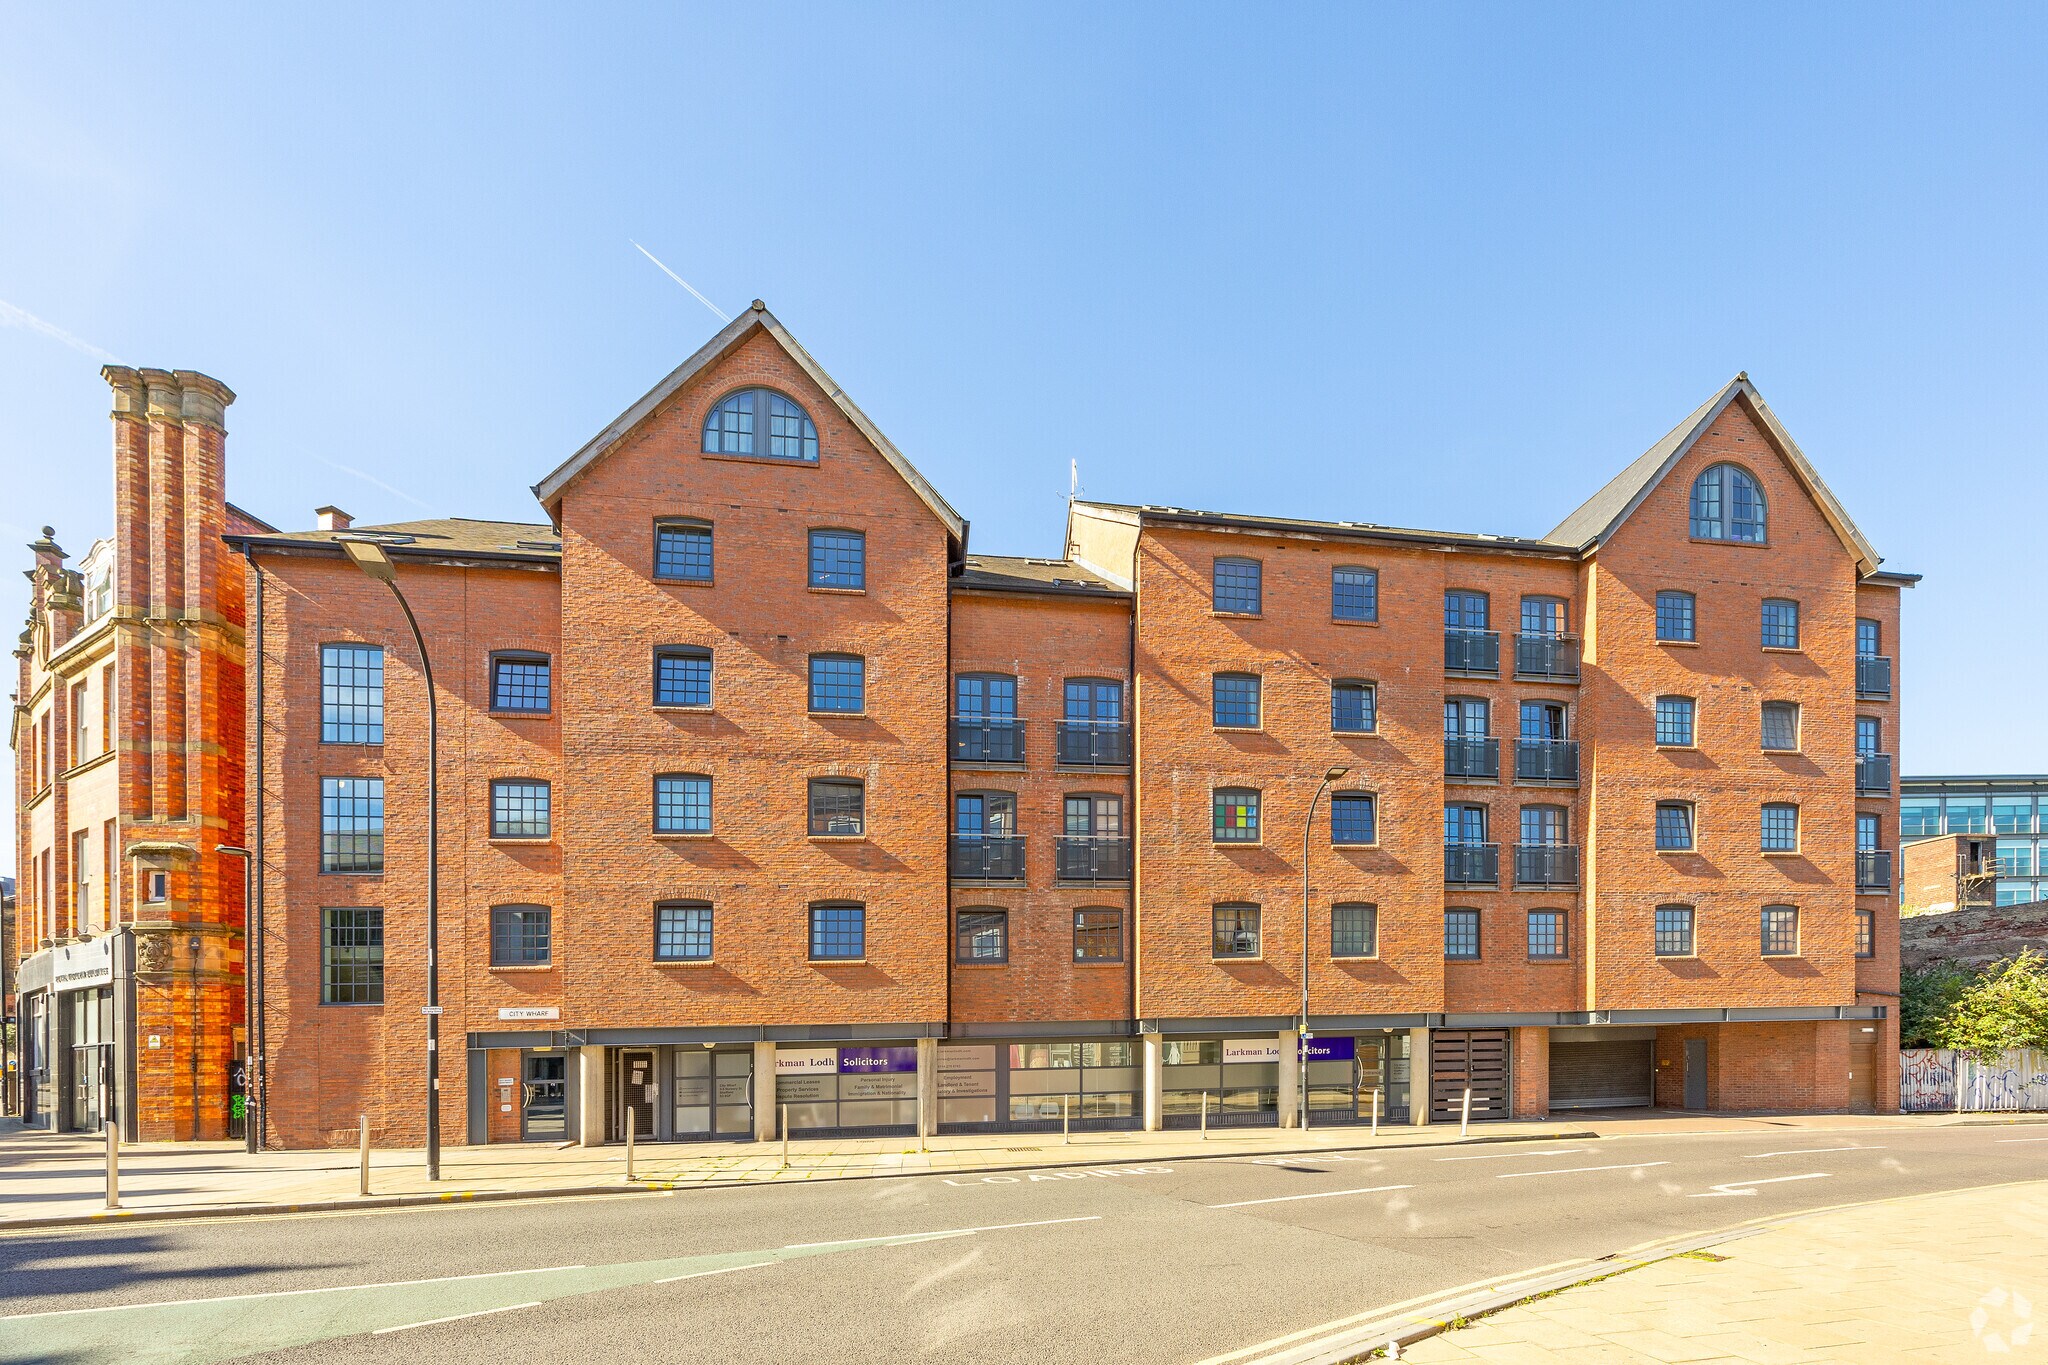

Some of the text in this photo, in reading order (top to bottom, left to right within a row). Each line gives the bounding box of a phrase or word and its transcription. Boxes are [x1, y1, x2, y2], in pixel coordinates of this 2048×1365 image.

[1226, 1047, 1279, 1056] Larkman Lo
[775, 1058, 835, 1067] rkman Lodh
[843, 1057, 888, 1066] Solicitors
[942, 1166, 1174, 1186] LOADING
